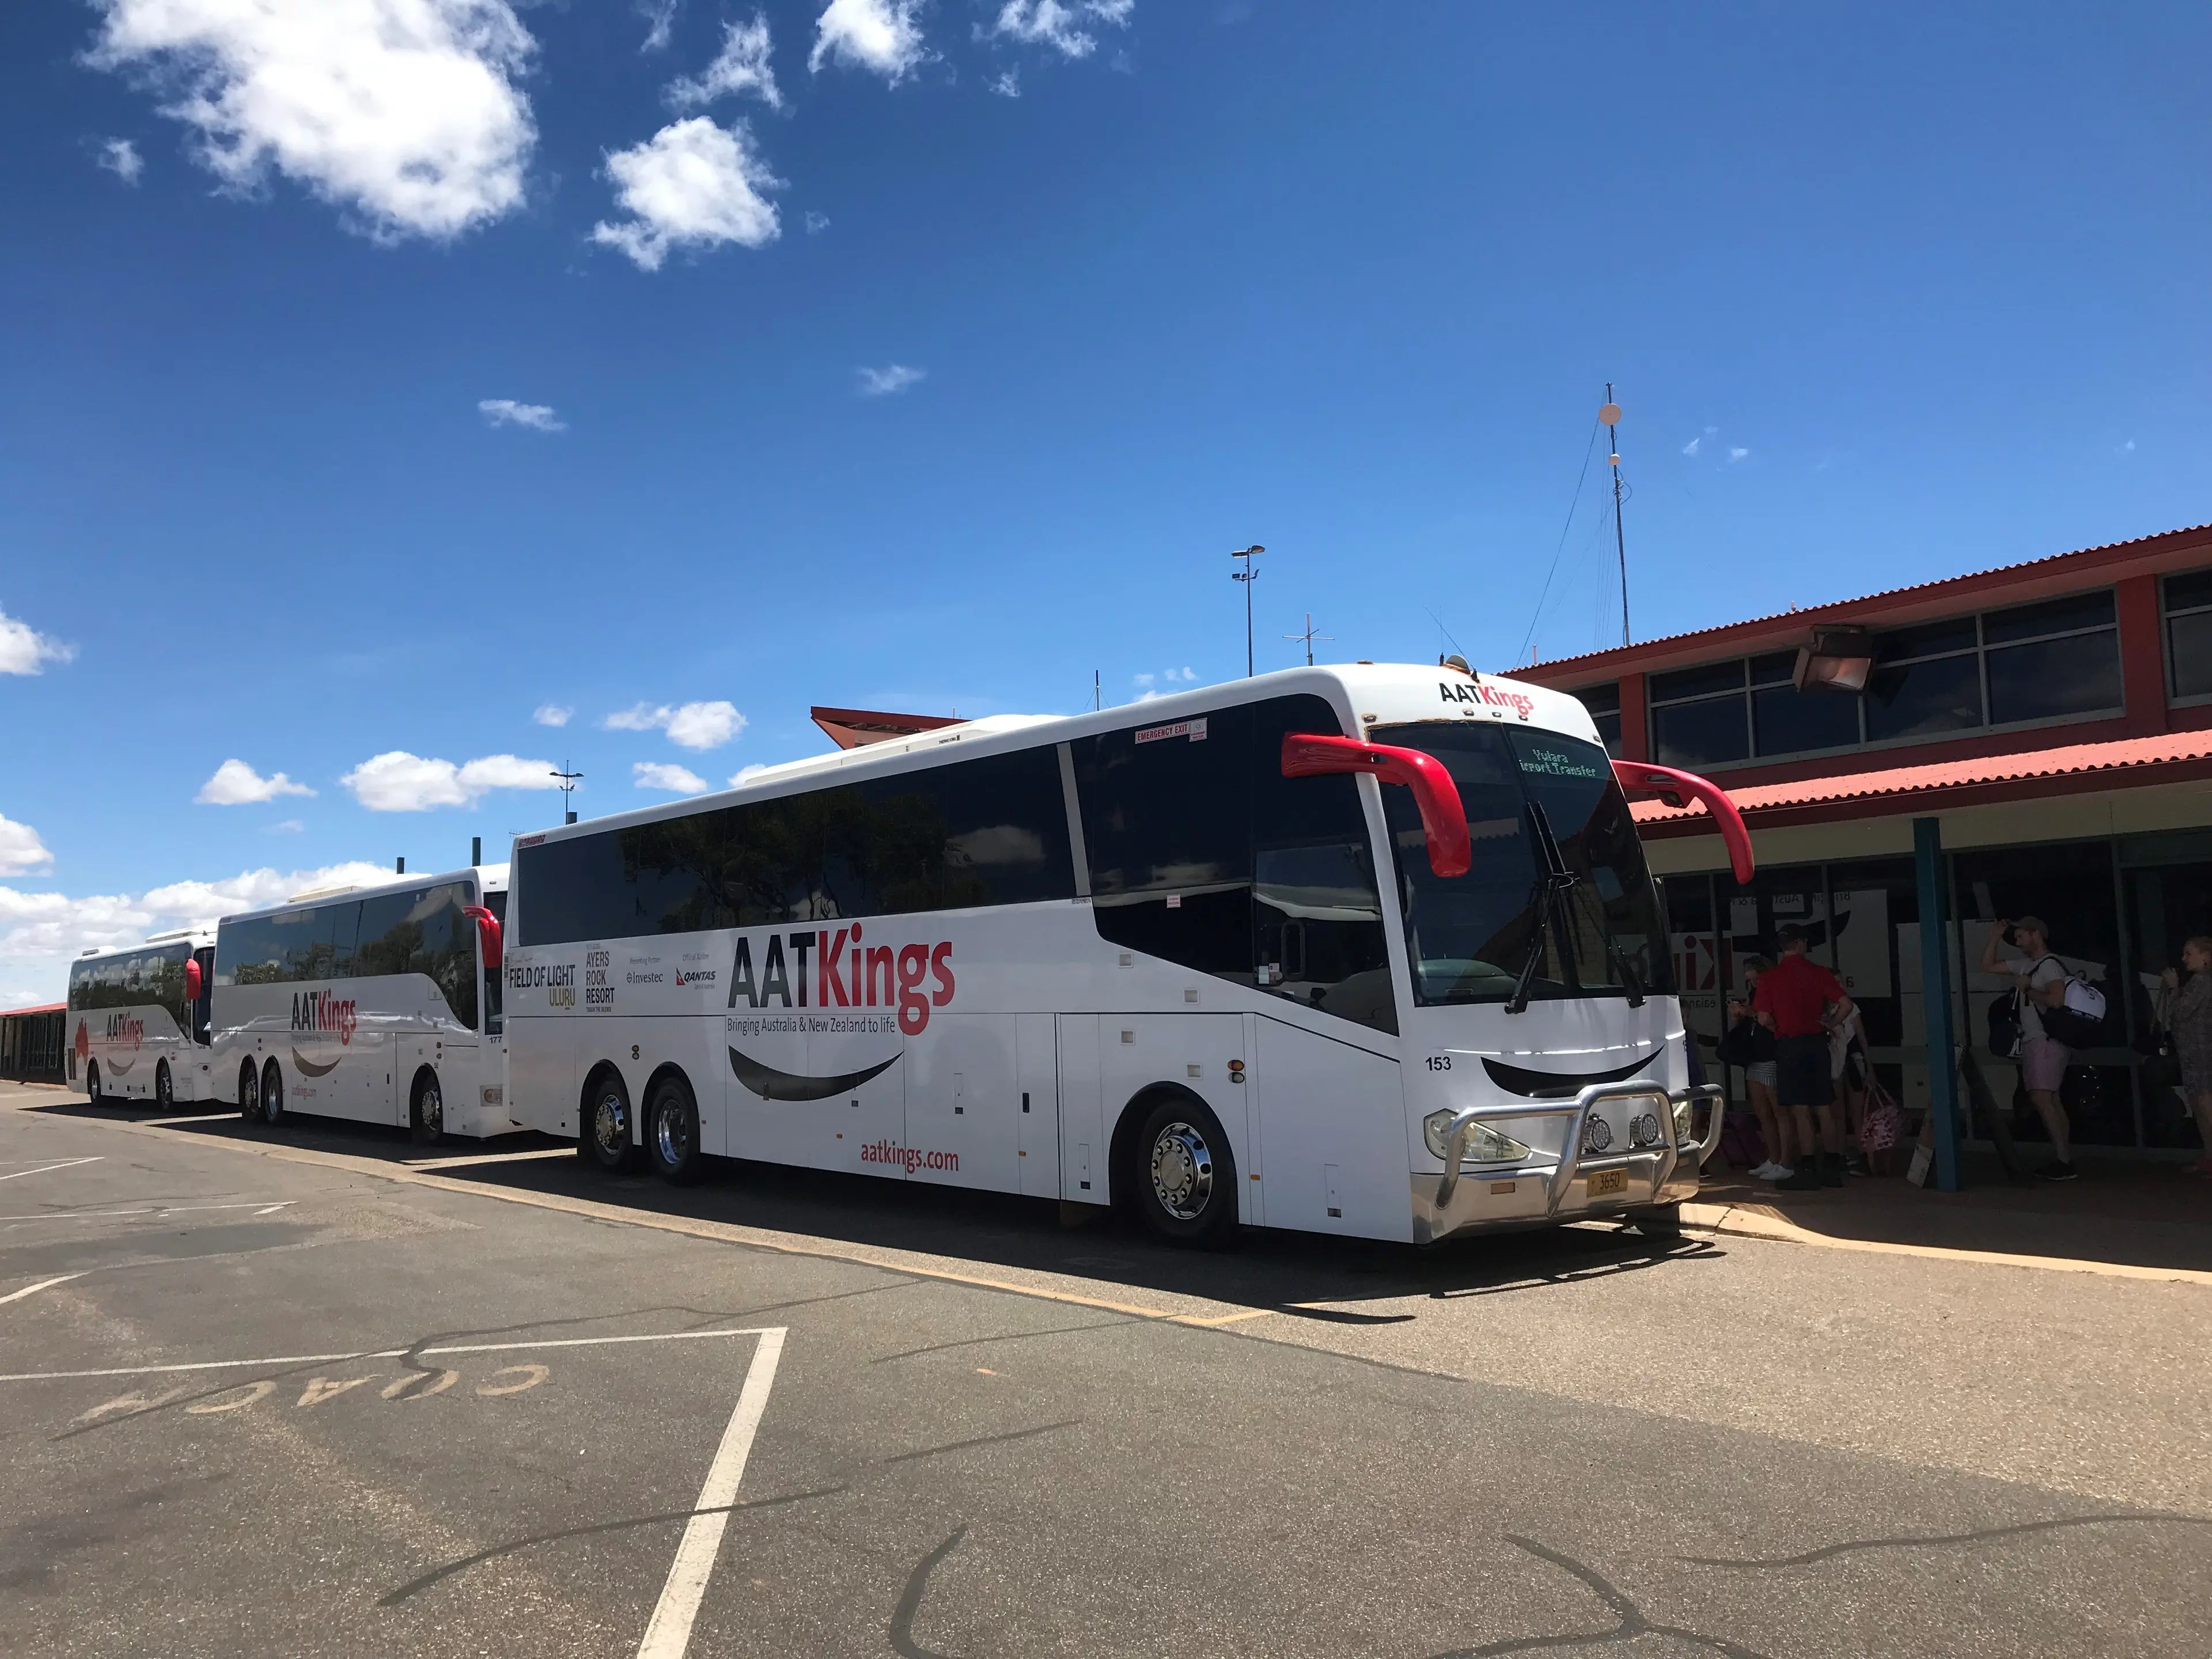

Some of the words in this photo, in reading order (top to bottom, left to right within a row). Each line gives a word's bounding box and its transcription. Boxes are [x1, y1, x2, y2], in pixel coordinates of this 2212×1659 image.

[1439, 683, 1533, 715] AATKings
[1137, 726, 1173, 741] EMERGENCY
[1175, 724, 1188, 734] EXIT
[1532, 749, 1569, 763] Yulara
[586, 951, 609, 968] AYERS
[510, 968, 532, 988] FIELD
[534, 966, 546, 987] OF
[547, 964, 575, 987] LIGHT
[586, 969, 607, 986] ROCK
[634, 971, 663, 984] Investec
[684, 971, 716, 983] QANTAS
[728, 922, 956, 1036] AATKings
[549, 988, 575, 1006] ULURU
[586, 987, 615, 1003] RESORT
[291, 988, 356, 1046] AATKings
[728, 1018, 759, 1036] Bringing
[762, 1018, 797, 1032] Australia
[799, 1017, 806, 1032] &
[809, 1018, 828, 1032] New
[831, 1017, 865, 1033] Zealand
[869, 1018, 878, 1033] to
[881, 1017, 895, 1033] life
[1426, 1056, 1451, 1071] 153
[861, 1139, 959, 1174] aatkings.com
